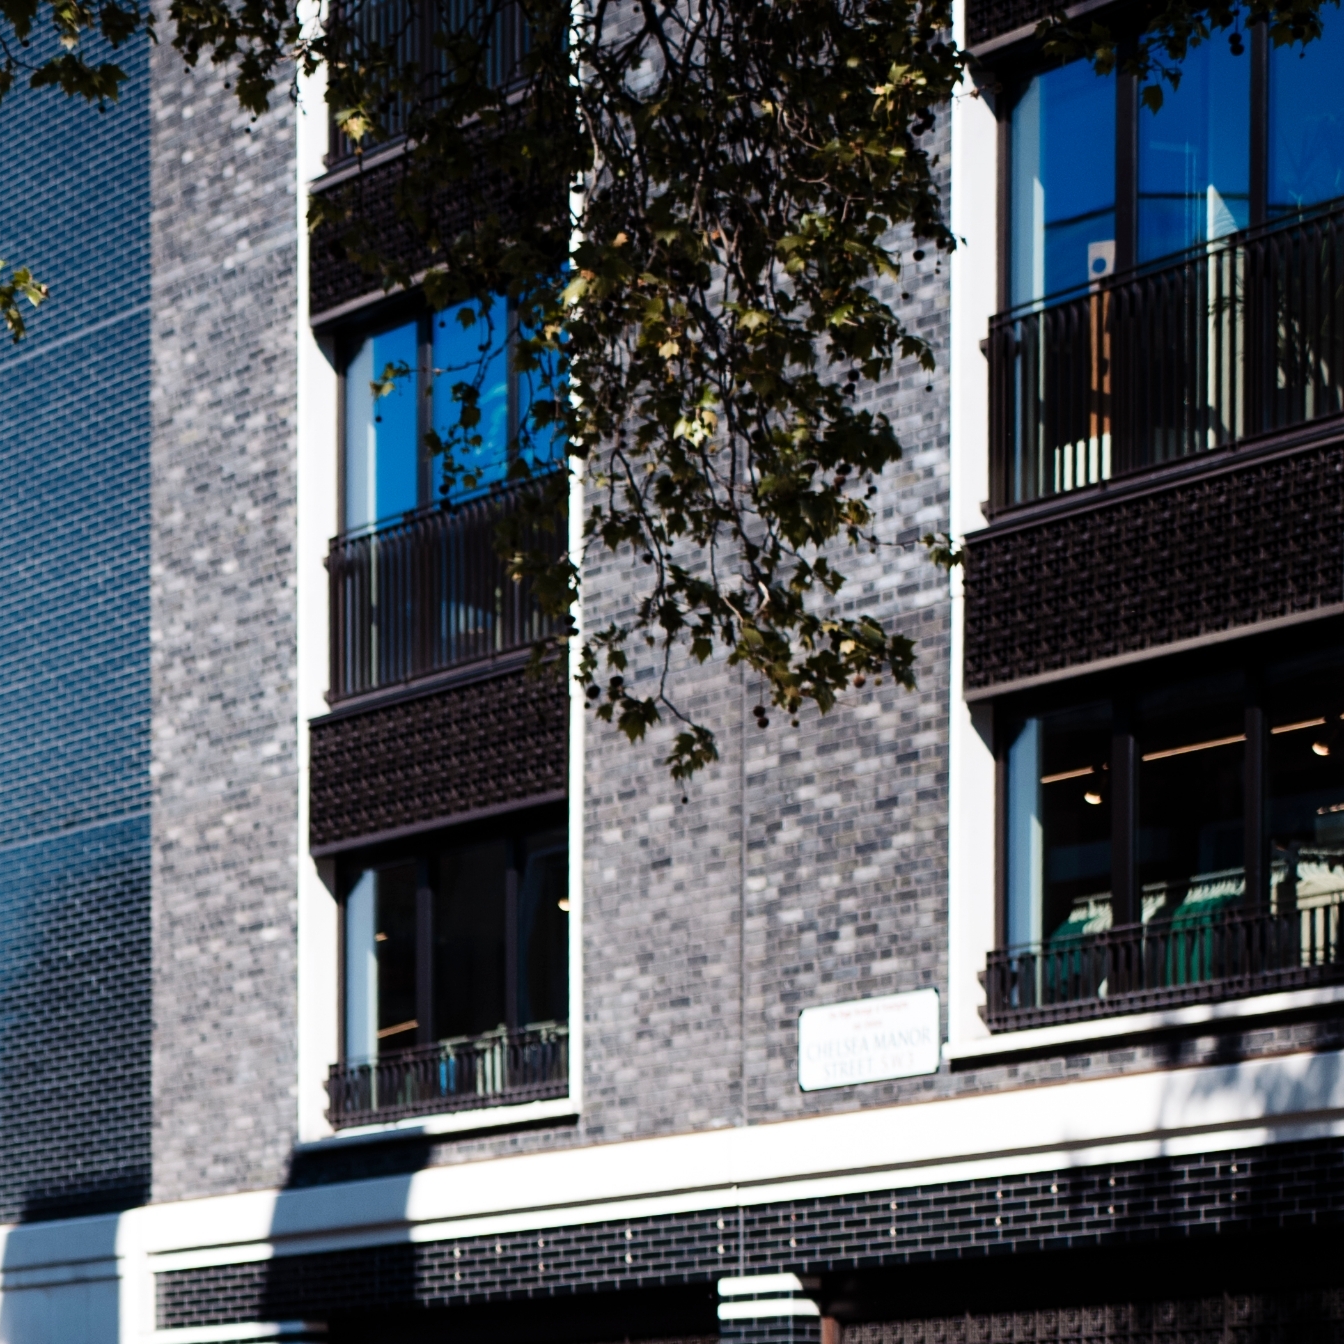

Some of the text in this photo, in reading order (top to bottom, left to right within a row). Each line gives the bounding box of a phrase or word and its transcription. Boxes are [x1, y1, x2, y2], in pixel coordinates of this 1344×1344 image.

[806, 1024, 931, 1062] CHELSEA MANOR
[823, 1055, 872, 1079] STREET
